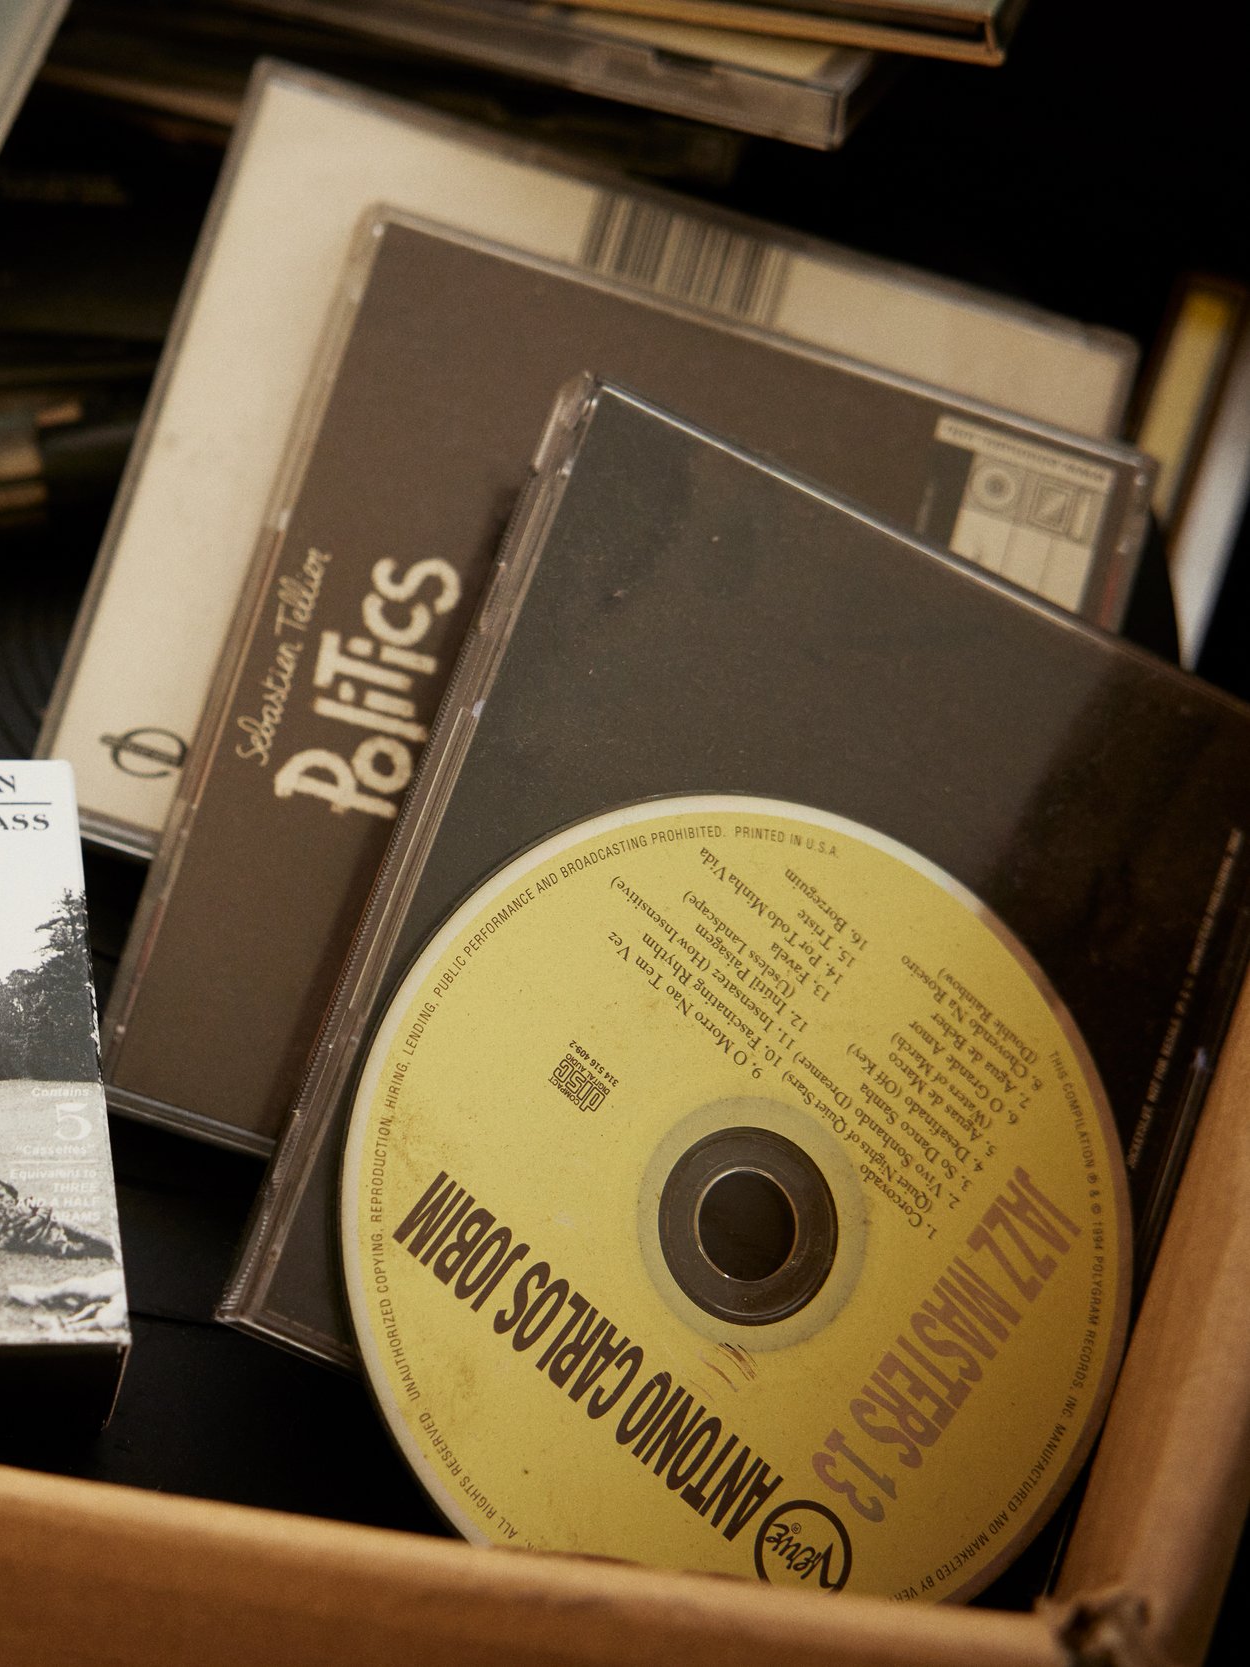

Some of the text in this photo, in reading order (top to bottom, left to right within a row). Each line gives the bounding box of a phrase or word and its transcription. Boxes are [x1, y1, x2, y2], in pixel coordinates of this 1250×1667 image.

[273, 546, 333, 639] Tellier
[681, 889, 796, 999] (Useless Landscape)
[698, 846, 844, 985] 14. Por Todo Minha Vida
[784, 867, 868, 951] 16. Borzeguim
[796, 908, 856, 968] 15. Triste
[606, 930, 764, 1080] 9. O Morro Nao Tem Vez
[616, 880, 796, 1051] 11. Insensatez (How Insensitive)
[641, 932, 783, 1068] 10. Fascinating Rhythm
[694, 922, 808, 1033] 12. Inútil Paisagem
[769, 941, 831, 1003] 13. Favela
[900, 954, 1044, 1092] 8. Chovendo Na Roseiro
[929, 1012, 1032, 1110] 7. Agua de Beber
[936, 967, 1040, 1066] (Double Rainbow)
[31, 1087, 90, 1098] Contains
[546, 1075, 583, 1106] COMPACT
[547, 1058, 608, 1112] disc
[564, 1052, 611, 1096] DIGITAL AUDIO
[568, 1038, 619, 1088] 314 516 409-2
[845, 1042, 984, 1172] 4. Desafinado (Off Key)
[887, 1051, 998, 1158] 5. Aguas de Marco
[889, 1031, 993, 1130] (Waters of March)
[907, 1020, 1020, 1126] 6. O Grande Amor
[1045, 1049, 1068, 1082] THIS
[54, 1101, 93, 1141] 5
[780, 1069, 933, 1214] (Quiet Nights of Quiet Stars)
[791, 1050, 961, 1210] 2. Vivo Sonhando (Dreamer)
[859, 1081, 973, 1193] 3. So Danco Samba
[1059, 1080, 1096, 1169] COMPILATION
[9, 1168, 97, 1181] Equivalent to
[53, 1182, 99, 1194] THREE
[65, 1196, 99, 1208] HALF
[370, 824, 841, 1540] ALL RIGHTS RESERVED. UNAUTHORIZED COPYING, REPRODUCTION, HIRING, LENDING, PUBLIC PERFORMANCE AND BROADCASTING PROHIBITED. PRINTED IN U.S.A.
[858, 1163, 938, 1240] 1. Corcovado
[1090, 1221, 1104, 1250] 1994
[1086, 1254, 1104, 1326] POLYGRAM
[393, 1172, 781, 1539] ANTONIO CARLOS JOBIM
[812, 1165, 1082, 1524] JAZZ MASTERS 13
[1069, 1328, 1097, 1394] RECORDS,
[1005, 1421, 1068, 1515] MANUFACTURED
[933, 1530, 991, 1583] MARKETED
[986, 1509, 1012, 1538] AND
[887, 1584, 919, 1610] VER
[917, 1574, 936, 1594] BY
